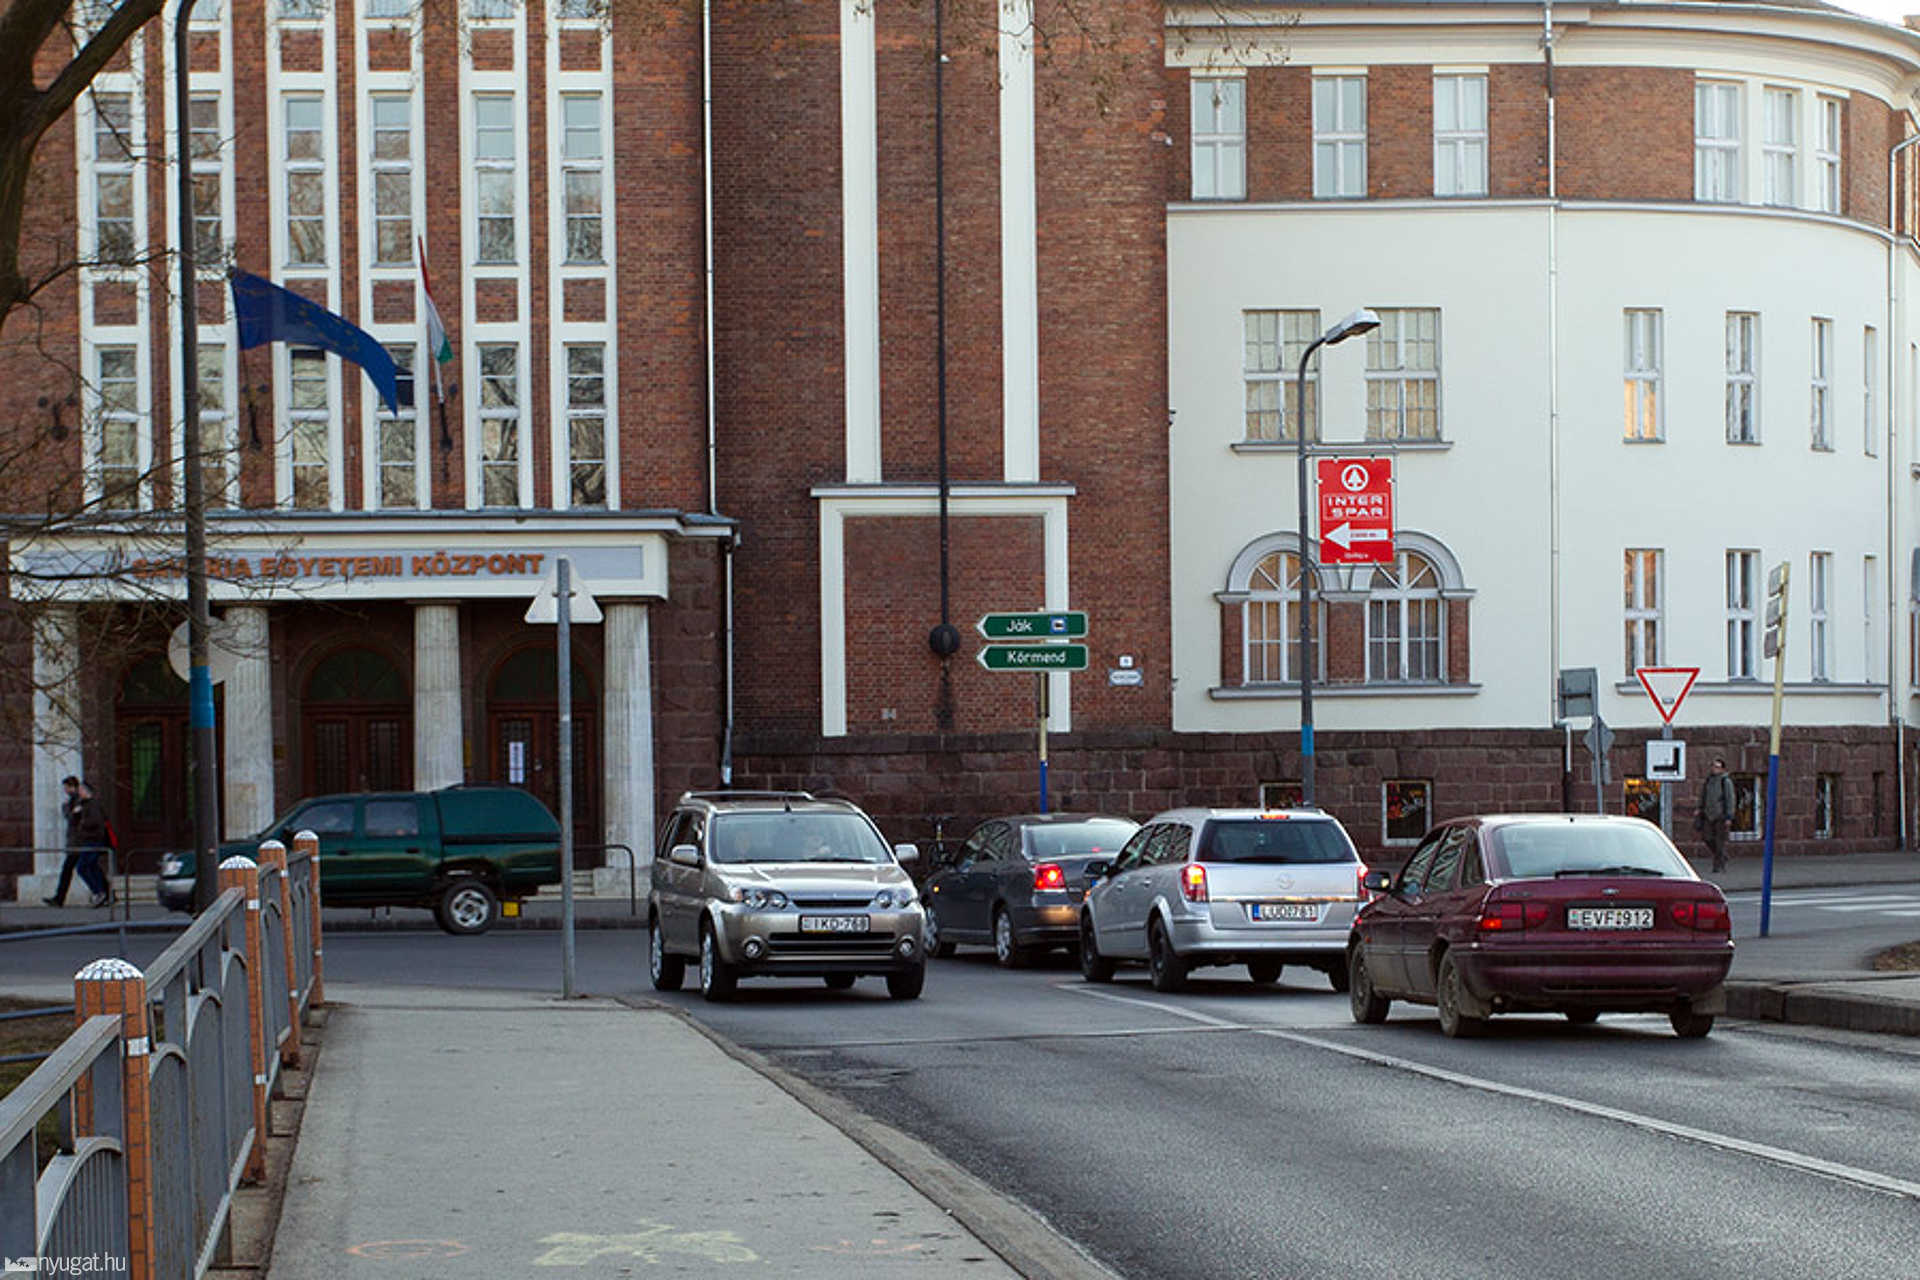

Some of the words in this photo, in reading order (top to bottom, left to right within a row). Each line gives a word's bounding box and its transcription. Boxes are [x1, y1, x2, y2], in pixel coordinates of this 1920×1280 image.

[1327, 495, 1383, 506] INTER
[1332, 507, 1383, 518] SPAR
[260, 556, 403, 577] EGYETEMI
[411, 551, 544, 577] KÖZPONT
